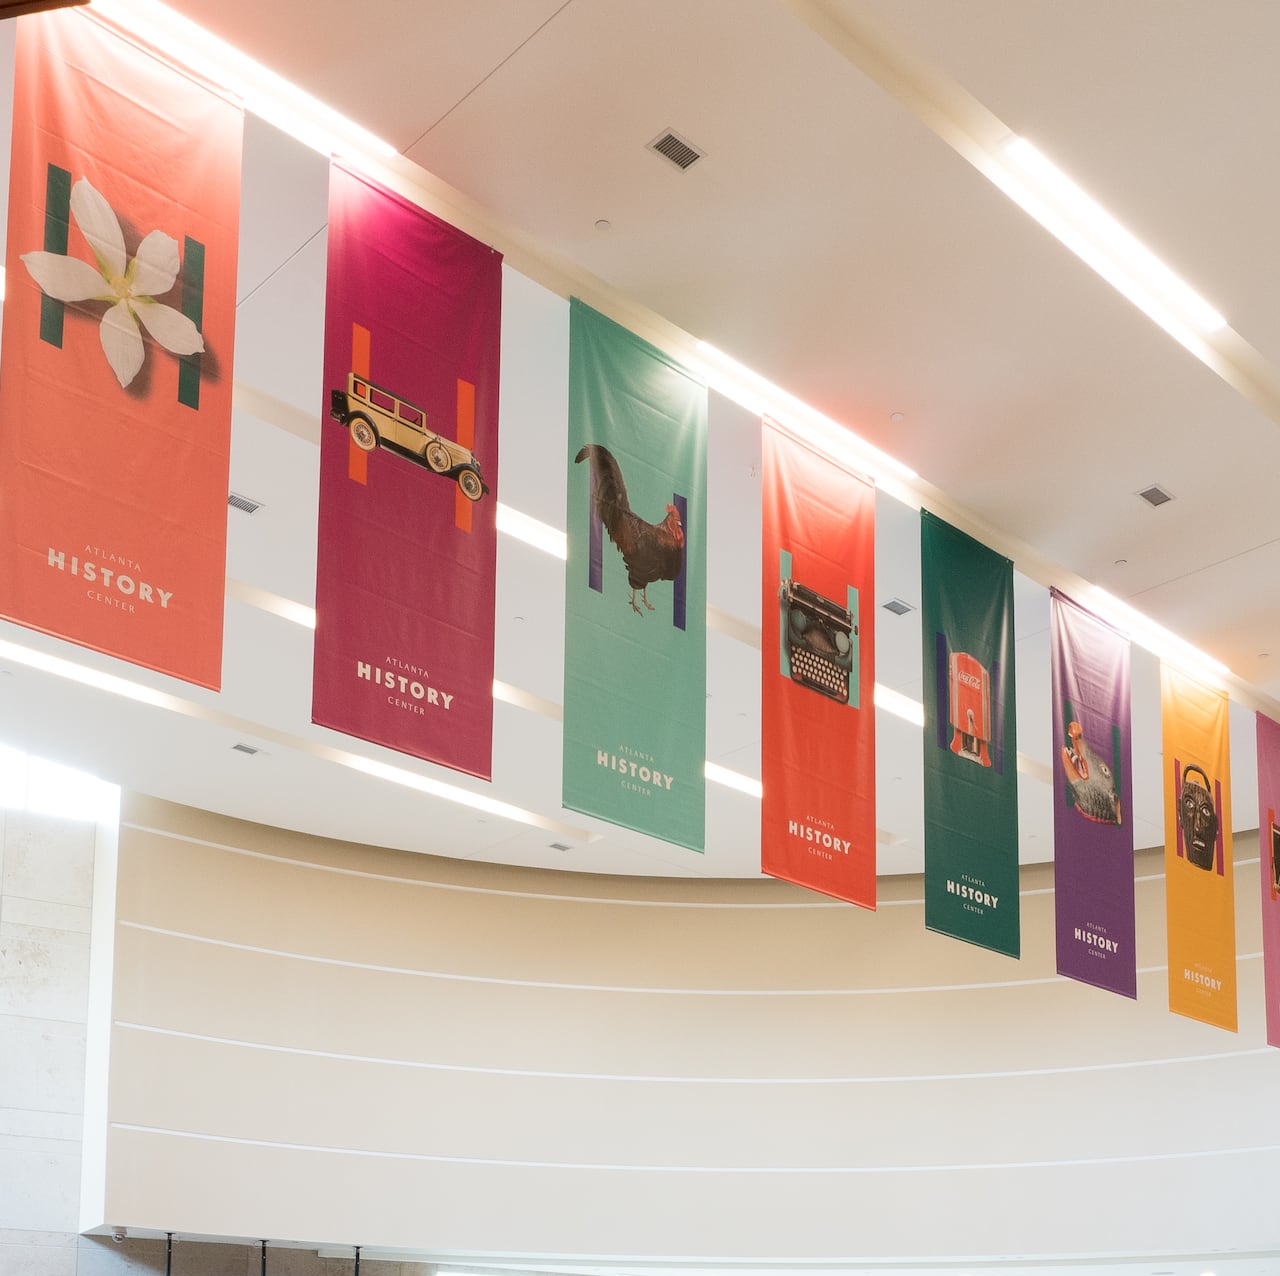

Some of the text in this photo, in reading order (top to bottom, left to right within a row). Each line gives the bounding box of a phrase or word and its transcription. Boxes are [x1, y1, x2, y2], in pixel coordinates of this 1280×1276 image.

[84, 544, 141, 572] ATLANTA
[48, 547, 173, 609] HISTORY
[86, 590, 136, 614] CENTER
[386, 656, 429, 679] ATLANTA
[357, 660, 454, 710] HISTORY
[387, 696, 425, 716] CENTER
[620, 744, 654, 763] ATLANTA
[597, 750, 674, 790] HISTORY
[621, 780, 651, 796] CENTER
[806, 815, 834, 832] ATLANTA
[788, 820, 851, 854] HISTORY
[808, 846, 832, 861] CENTER
[961, 874, 986, 888] ATLANTA
[946, 880, 998, 909] HISTORY
[962, 903, 984, 915] CENTER
[1074, 927, 1118, 954] HISTORY
[1184, 968, 1222, 992] HISTORY
